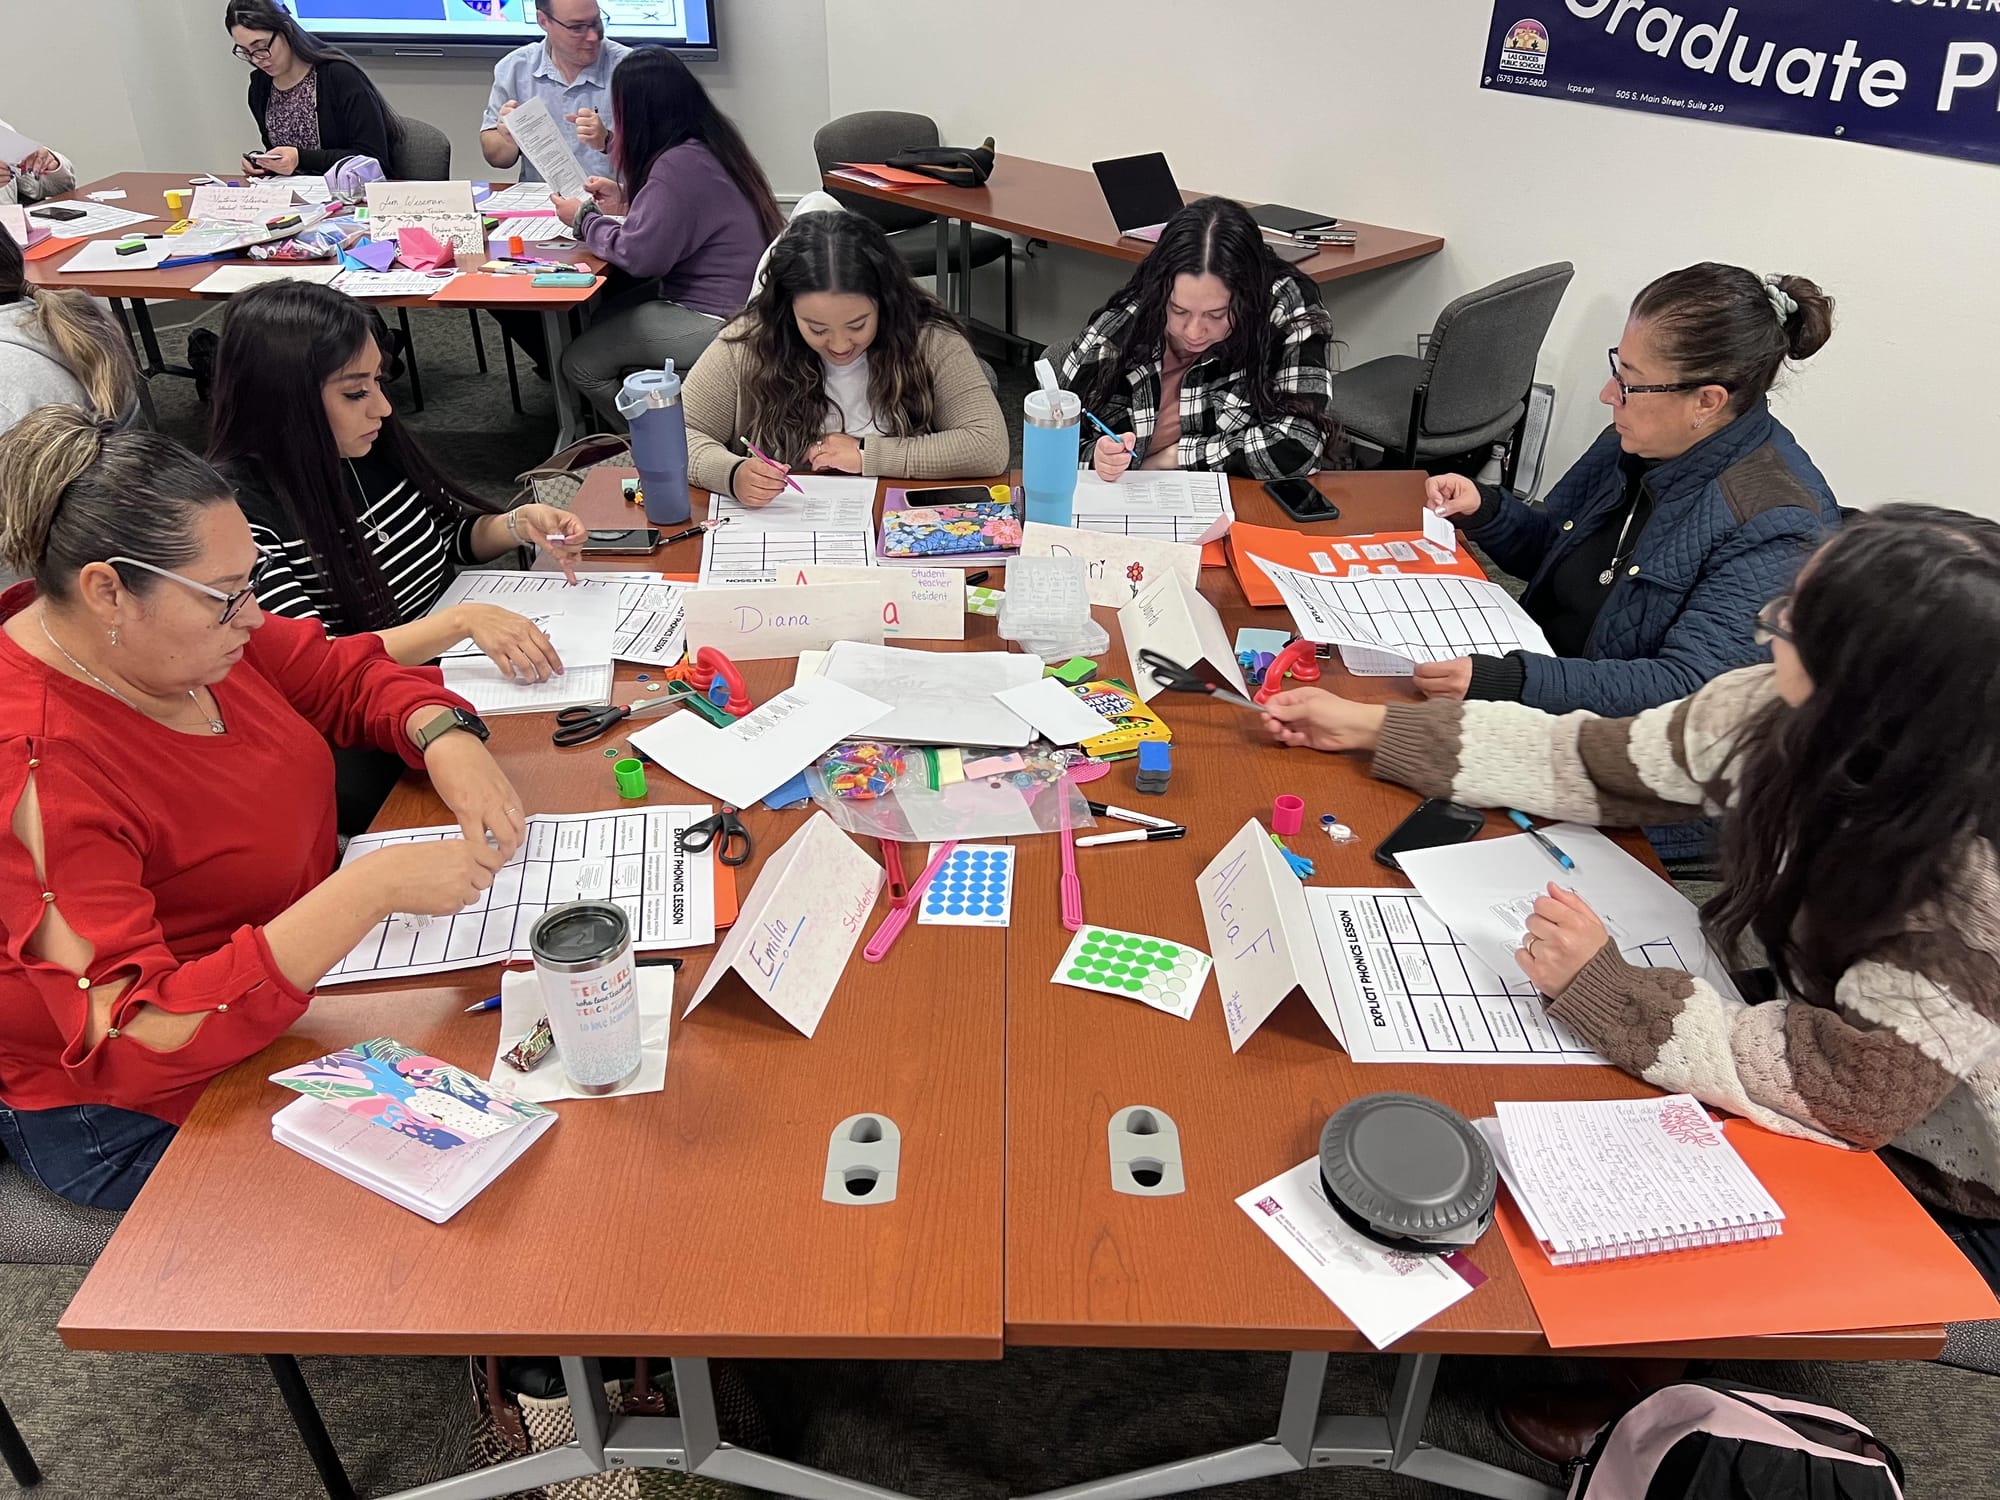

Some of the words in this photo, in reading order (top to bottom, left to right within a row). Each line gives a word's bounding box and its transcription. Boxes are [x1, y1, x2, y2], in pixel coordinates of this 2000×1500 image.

[1564, 0, 1907, 108] raduate
[1937, 42, 2000, 112] P
[1496, 74, 1514, 84] (575)
[1515, 76, 1548, 88] 527-5800
[1568, 83, 1595, 94] lcps.net
[1616, 90, 1630, 100] 505
[1632, 91, 1638, 101] S.
[1640, 93, 1660, 104] Main
[1662, 96, 1686, 109] Street,
[1687, 99, 1707, 111] Suite
[1708, 102, 1725, 113] 249
[911, 569, 946, 578] Student
[918, 578, 953, 588] teacher
[911, 590, 949, 601] Resident
[733, 606, 810, 634] Diana
[673, 860, 684, 892] PHONICS
[673, 895, 683, 925] LESSON
[842, 884, 877, 934] Student
[1212, 849, 1248, 945] Alicia
[1234, 928, 1276, 960] F
[1339, 910, 1359, 943] LESSON
[748, 918, 789, 978] Emilia
[1350, 945, 1373, 984] PHONICS
[1363, 986, 1386, 1027] EXPLICIT
